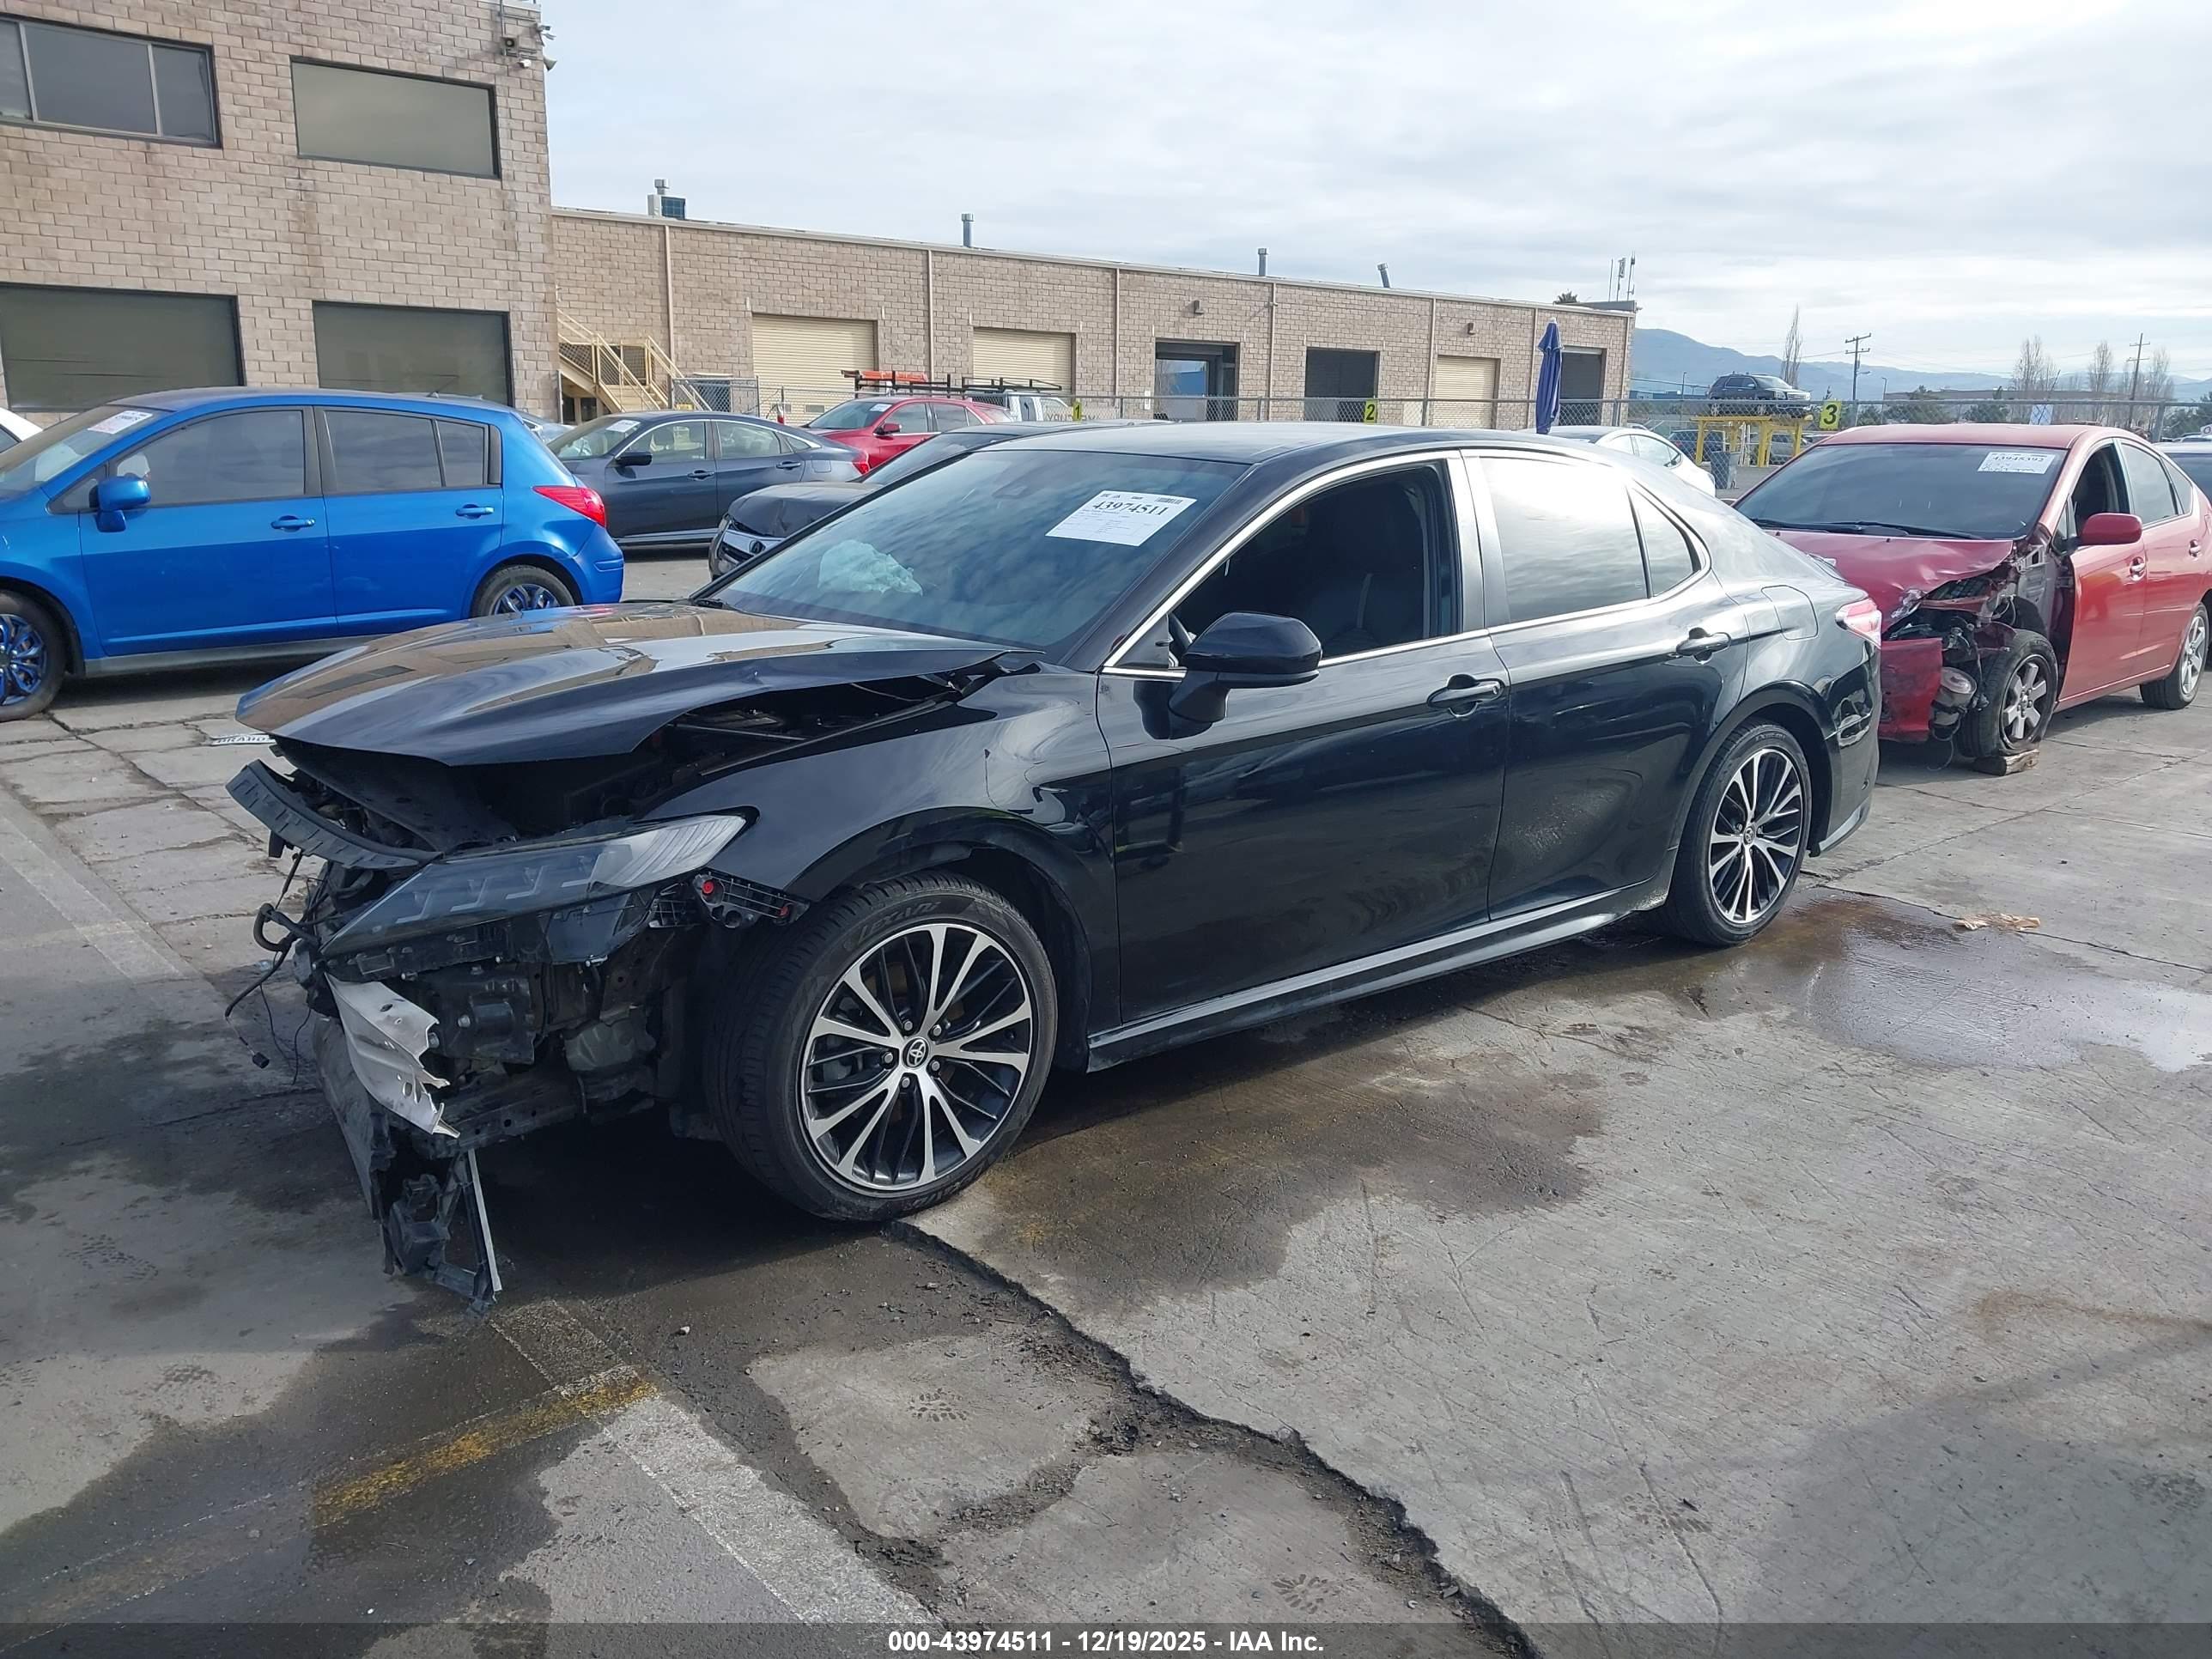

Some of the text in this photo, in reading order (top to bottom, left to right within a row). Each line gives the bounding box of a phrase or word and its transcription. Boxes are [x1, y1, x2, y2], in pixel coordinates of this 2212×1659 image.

[1365, 404, 1376, 421] 2
[1823, 404, 1838, 425] 3
[1092, 501, 1169, 516] 43974511
